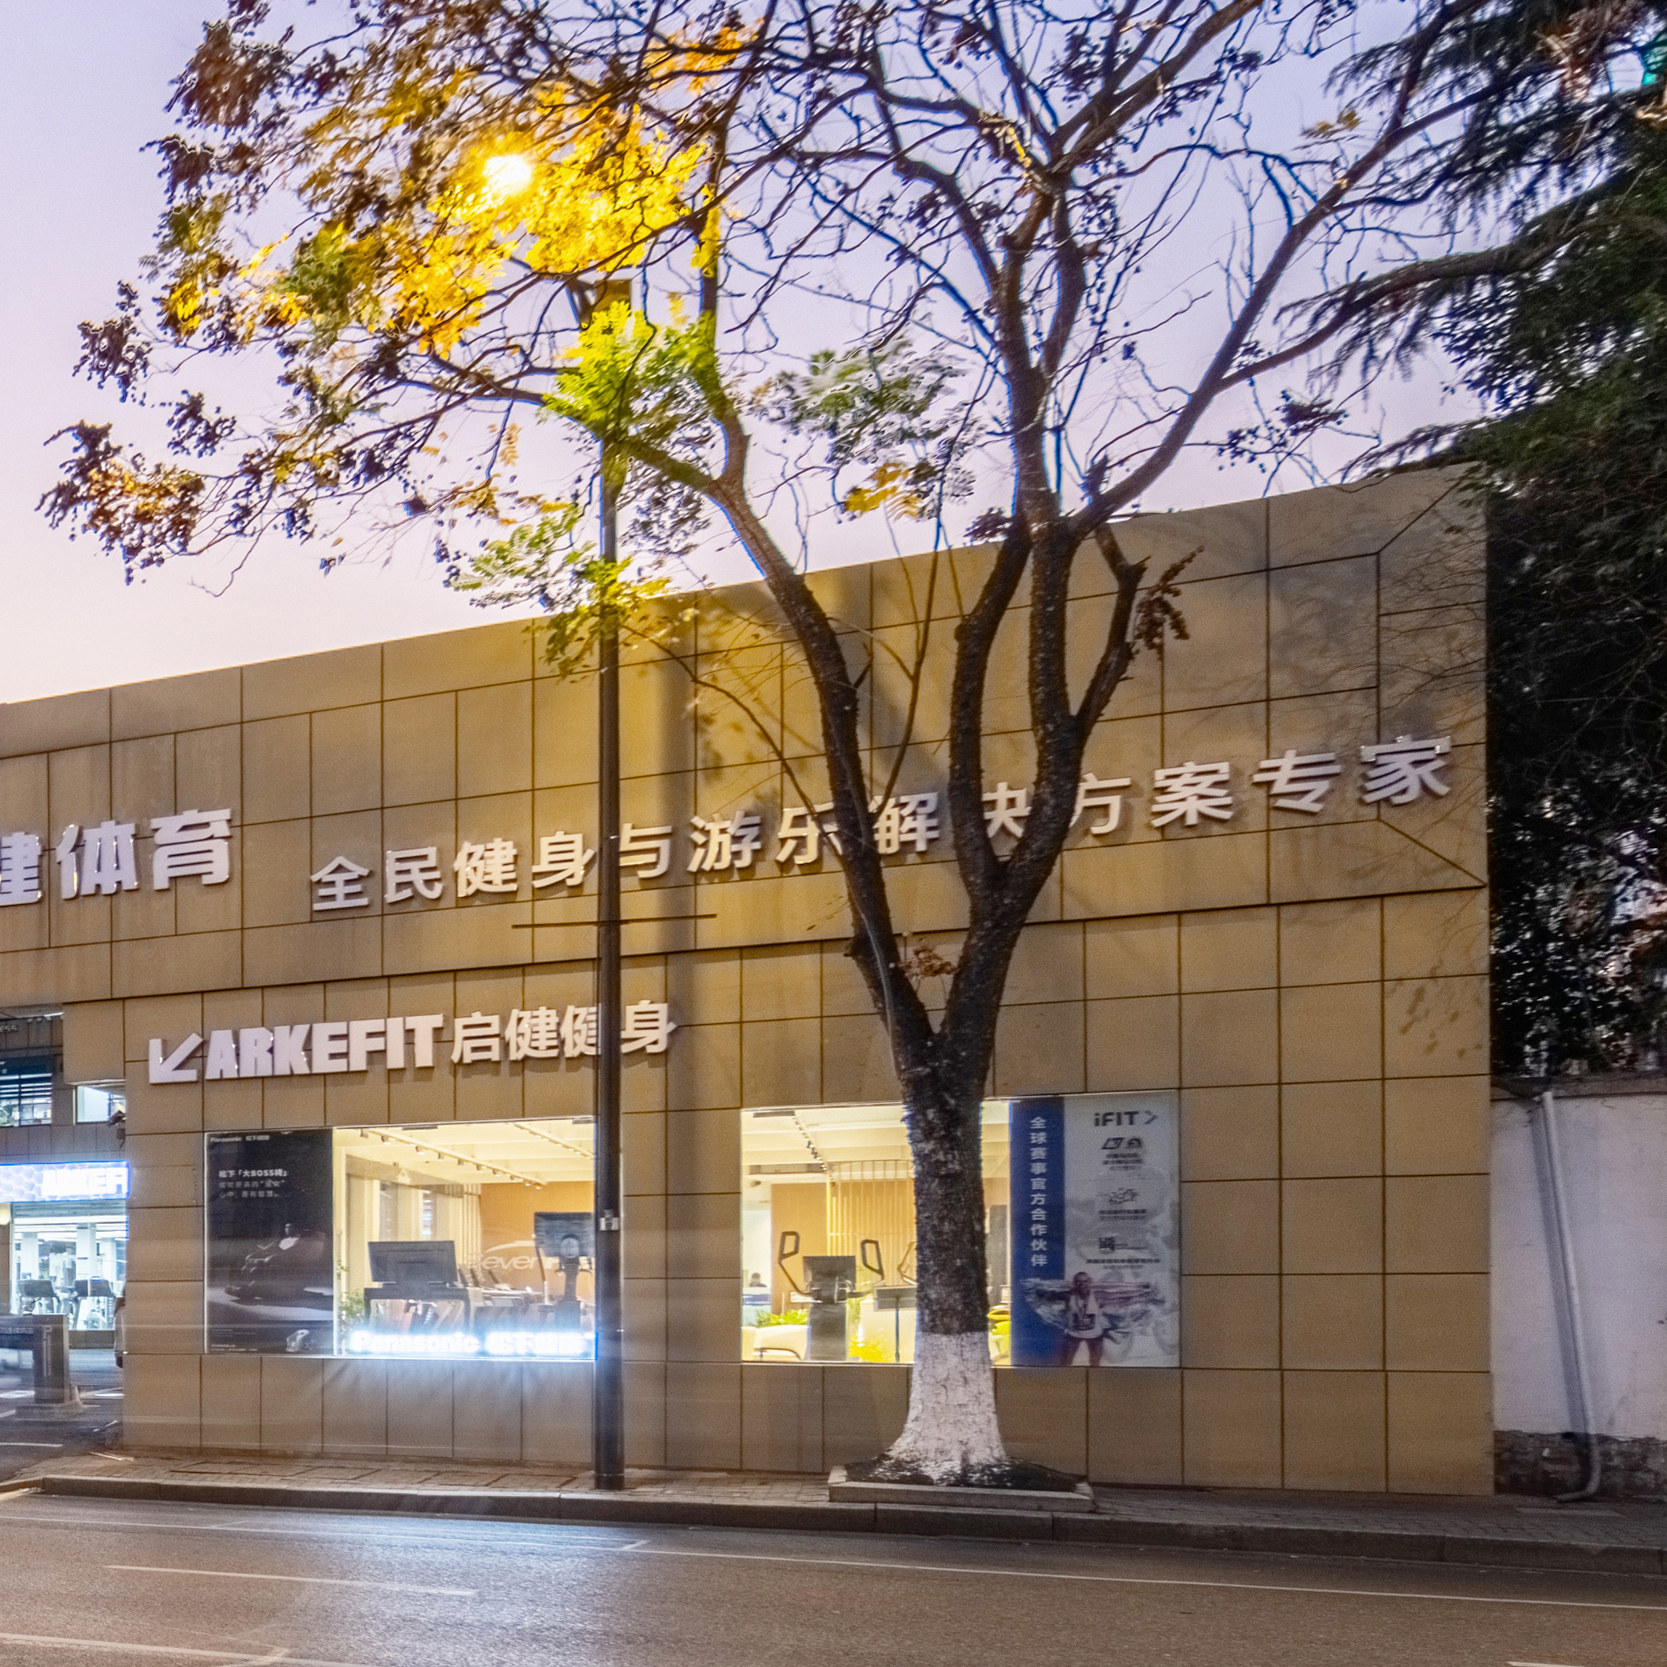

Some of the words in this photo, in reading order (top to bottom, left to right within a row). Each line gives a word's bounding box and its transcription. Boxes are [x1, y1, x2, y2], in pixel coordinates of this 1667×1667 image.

[451, 999, 678, 1064] 启健健身
[1094, 1110, 1140, 1127] iFIT
[1029, 1116, 1049, 1267] 全球赛事官方合作伙伴
[353, 1331, 480, 1352] Panasonic
